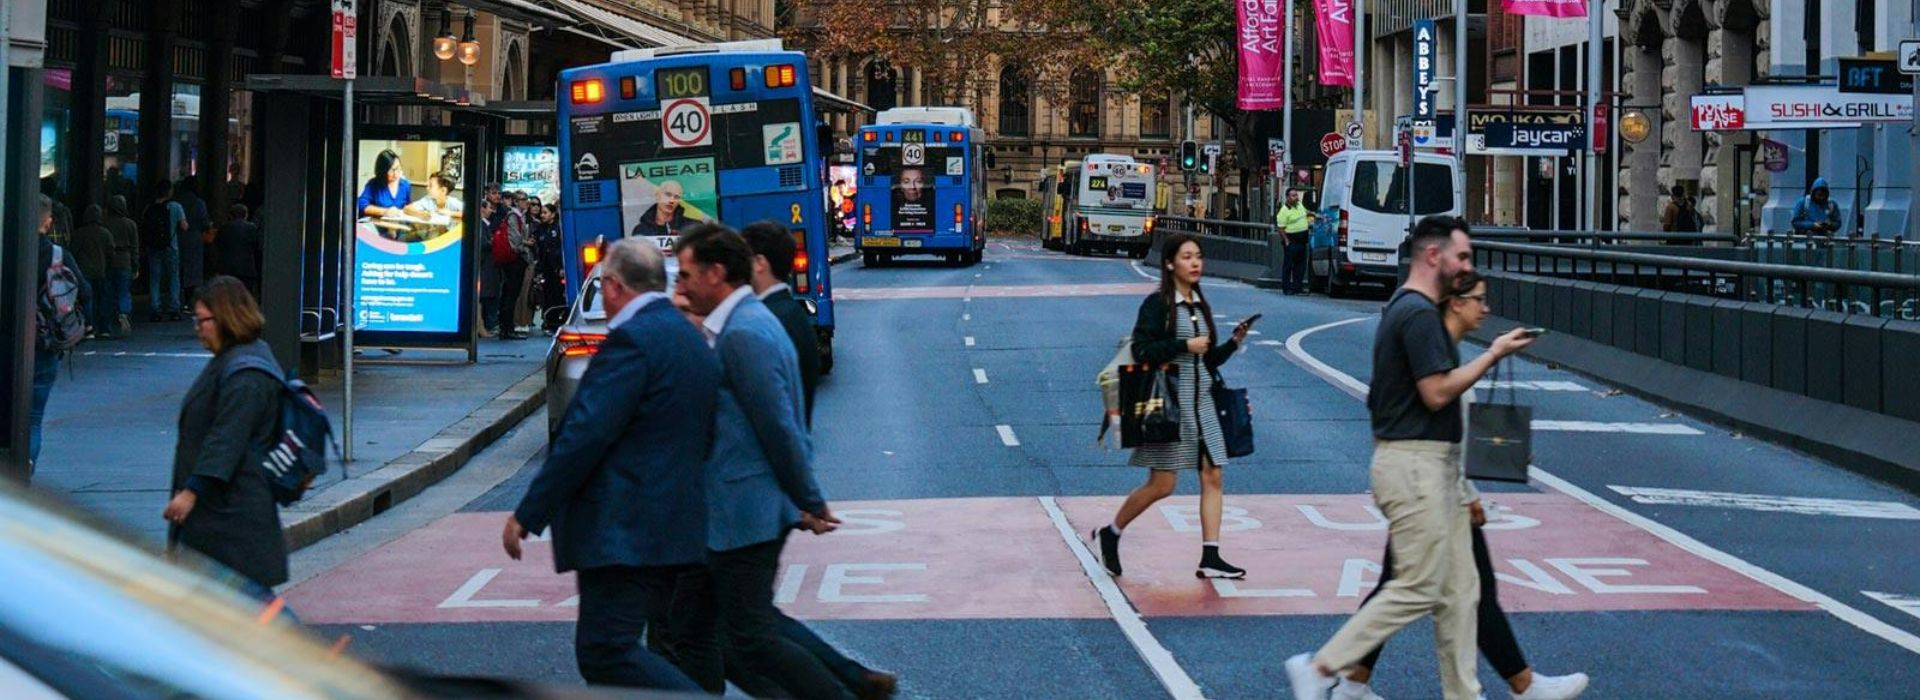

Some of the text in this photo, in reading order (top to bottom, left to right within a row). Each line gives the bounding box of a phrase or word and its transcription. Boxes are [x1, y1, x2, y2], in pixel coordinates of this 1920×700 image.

[1262, 26, 1278, 53] Art
[1417, 27, 1431, 115] ABBEYS
[665, 72, 702, 96] 100
[1771, 103, 1820, 117] SUSHI
[1823, 102, 1842, 116] &
[1846, 103, 1896, 117] GRILL
[670, 111, 702, 134] 40
[1510, 125, 1572, 146] jaycar
[906, 149, 921, 159] 40
[1322, 140, 1345, 153] STOP
[625, 163, 710, 179] LA GEAR
[1091, 180, 1105, 188] 274
[656, 237, 675, 247] TA
